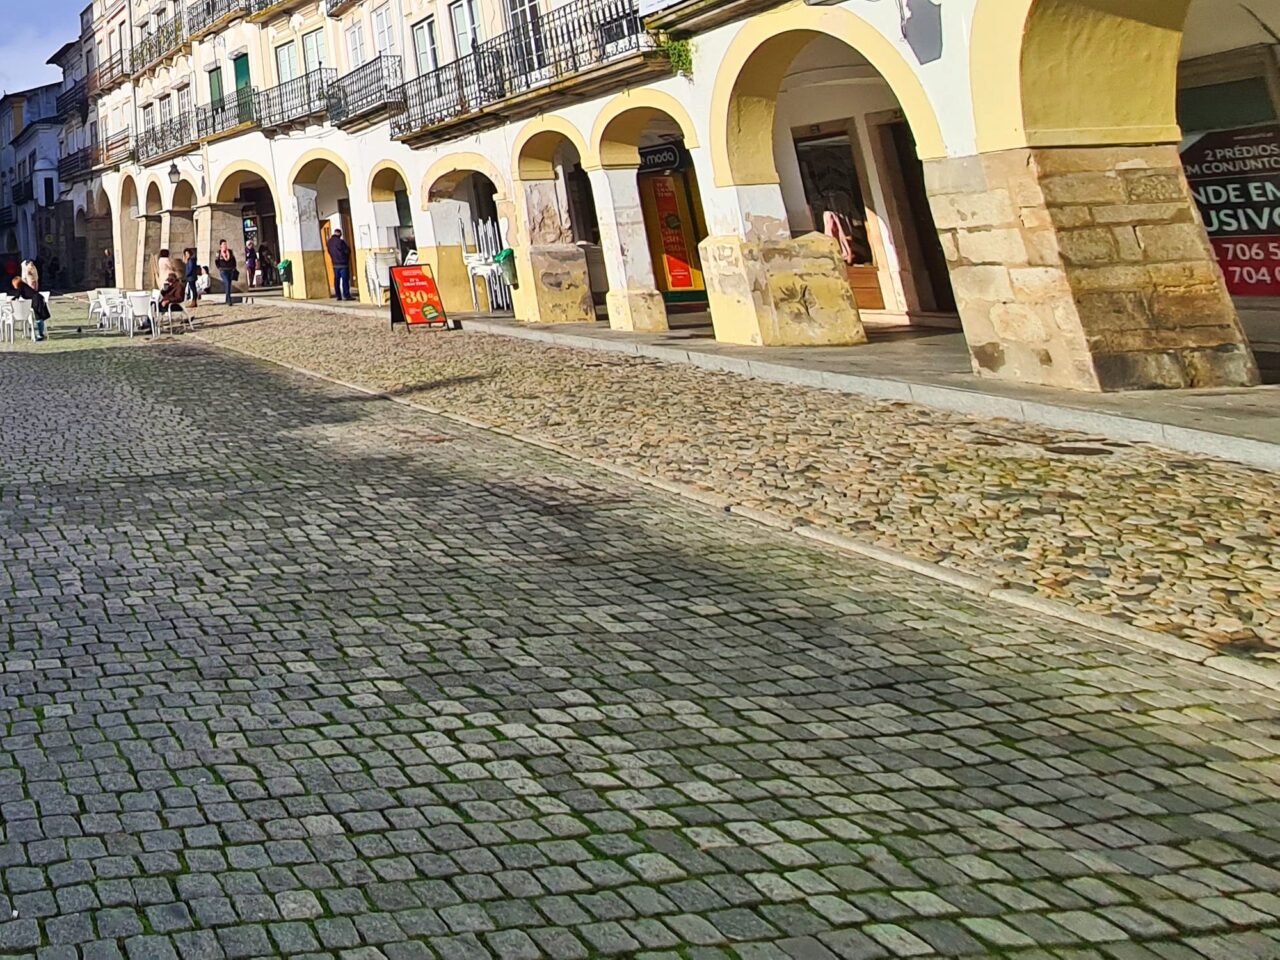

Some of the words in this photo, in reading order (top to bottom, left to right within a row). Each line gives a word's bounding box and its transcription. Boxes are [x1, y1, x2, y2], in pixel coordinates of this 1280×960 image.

[646, 151, 674, 165] moda
[1204, 150, 1214, 160] 2
[1215, 143, 1280, 160] PRÉDIOS
[1192, 183, 1246, 204] NDE
[1221, 242, 1264, 260] 706
[1228, 266, 1271, 284] 704
